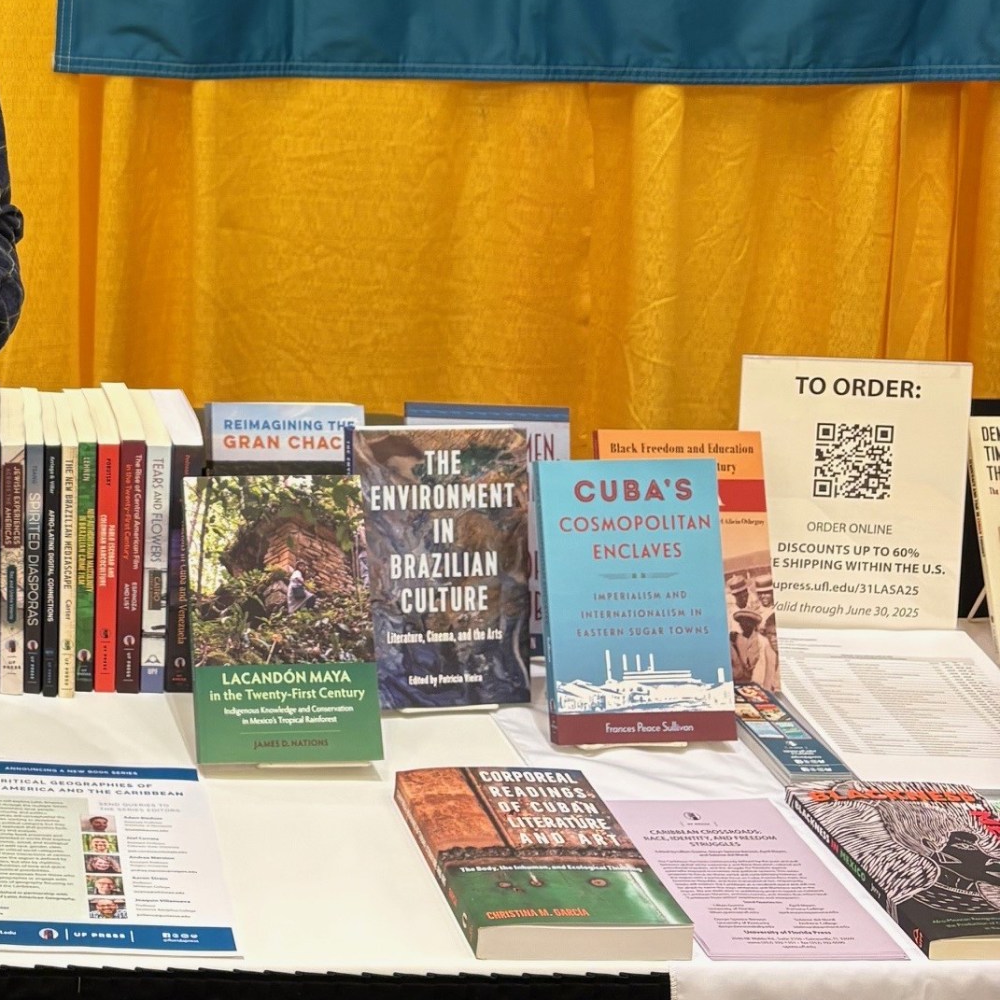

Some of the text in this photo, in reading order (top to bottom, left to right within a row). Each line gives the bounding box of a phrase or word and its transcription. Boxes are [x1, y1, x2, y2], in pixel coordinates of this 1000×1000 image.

[795, 376, 921, 399] TO ORDER:
[223, 419, 355, 431] REIMAGINING THE
[223, 435, 342, 450] GRAN CHAC
[610, 442, 754, 454] Black Freedom and Education
[135, 454, 143, 467] The
[424, 449, 462, 476] THE
[134, 468, 142, 483] Rise
[152, 457, 165, 489] TEARS
[370, 482, 516, 512] ENVIRONMENT
[573, 478, 693, 503] CUBA'S
[13, 466, 21, 545] JEWISH EXPERIENCES
[133, 493, 142, 519] Central
[153, 490, 163, 510] AND
[5, 507, 13, 545] AMERICAS
[63, 459, 74, 589] THE NEW BRAZILIAN MEDIASCAPE
[433, 518, 455, 545] IN
[559, 514, 712, 533] COSMOPOLITAN
[806, 521, 893, 535] ORDER ONLINE
[132, 519, 141, 552] American
[150, 513, 163, 562] FLOWERS
[122, 531, 131, 560] Century
[592, 542, 682, 560] ENCLAVES
[777, 542, 920, 558] DISCOUNTS UP TO 60%
[27, 492, 41, 626] SPIRITED DIASPORAS
[46, 552, 54, 576] DIGITAL
[390, 550, 499, 580] BRAZILIAN
[782, 558, 843, 571] SHIPPING
[845, 560, 893, 573] WITHIN
[894, 563, 920, 574] THE
[922, 564, 946, 575] U.S.
[46, 577, 54, 622] CONNECTIONS
[401, 586, 489, 614] CULTURE
[593, 589, 687, 601] IMPERIALISM AND
[580, 607, 703, 619] INTERNATIONALISM IN
[799, 602, 844, 616] through
[845, 605, 872, 616] June
[873, 606, 889, 618] 30,
[892, 606, 920, 618] 2025
[177, 604, 188, 645] Venezuela
[576, 625, 710, 637] EASTERN SUGAR TOWNS
[387, 631, 425, 645] Literature,
[457, 628, 472, 641] and
[473, 628, 486, 640] the
[487, 627, 503, 641] Arts
[221, 669, 352, 686] LACANDÓN MAYA
[408, 675, 429, 685] Edited
[430, 674, 438, 687] by
[209, 686, 365, 702] in the Twenty-First Century
[223, 705, 354, 717] Indigenous Knowledge and Conservation
[278, 715, 338, 726] Tropical Rainforest
[605, 721, 694, 733] Frances Peace Sullivan
[253, 740, 280, 750] JAMES
[49, 780, 134, 788] GEOGRAPHIES
[478, 770, 580, 784] CORPOREAL
[1, 785, 54, 793] AMERICA
[115, 789, 184, 797] CARIBBEAN
[488, 785, 588, 799] READINGS
[808, 788, 977, 803] BLACKNESS
[497, 801, 599, 814] OF CUBAN
[506, 814, 611, 831] LITERATURE
[519, 832, 622, 847] AND ART
[649, 829, 700, 837] CARIBBEAN
[713, 835, 732, 843] AND
[733, 835, 778, 843] FREEDOM
[793, 801, 867, 883] BLACKNESS IN MEXICO
[485, 908, 538, 921] CHRISTINA
[538, 908, 553, 918] M.
